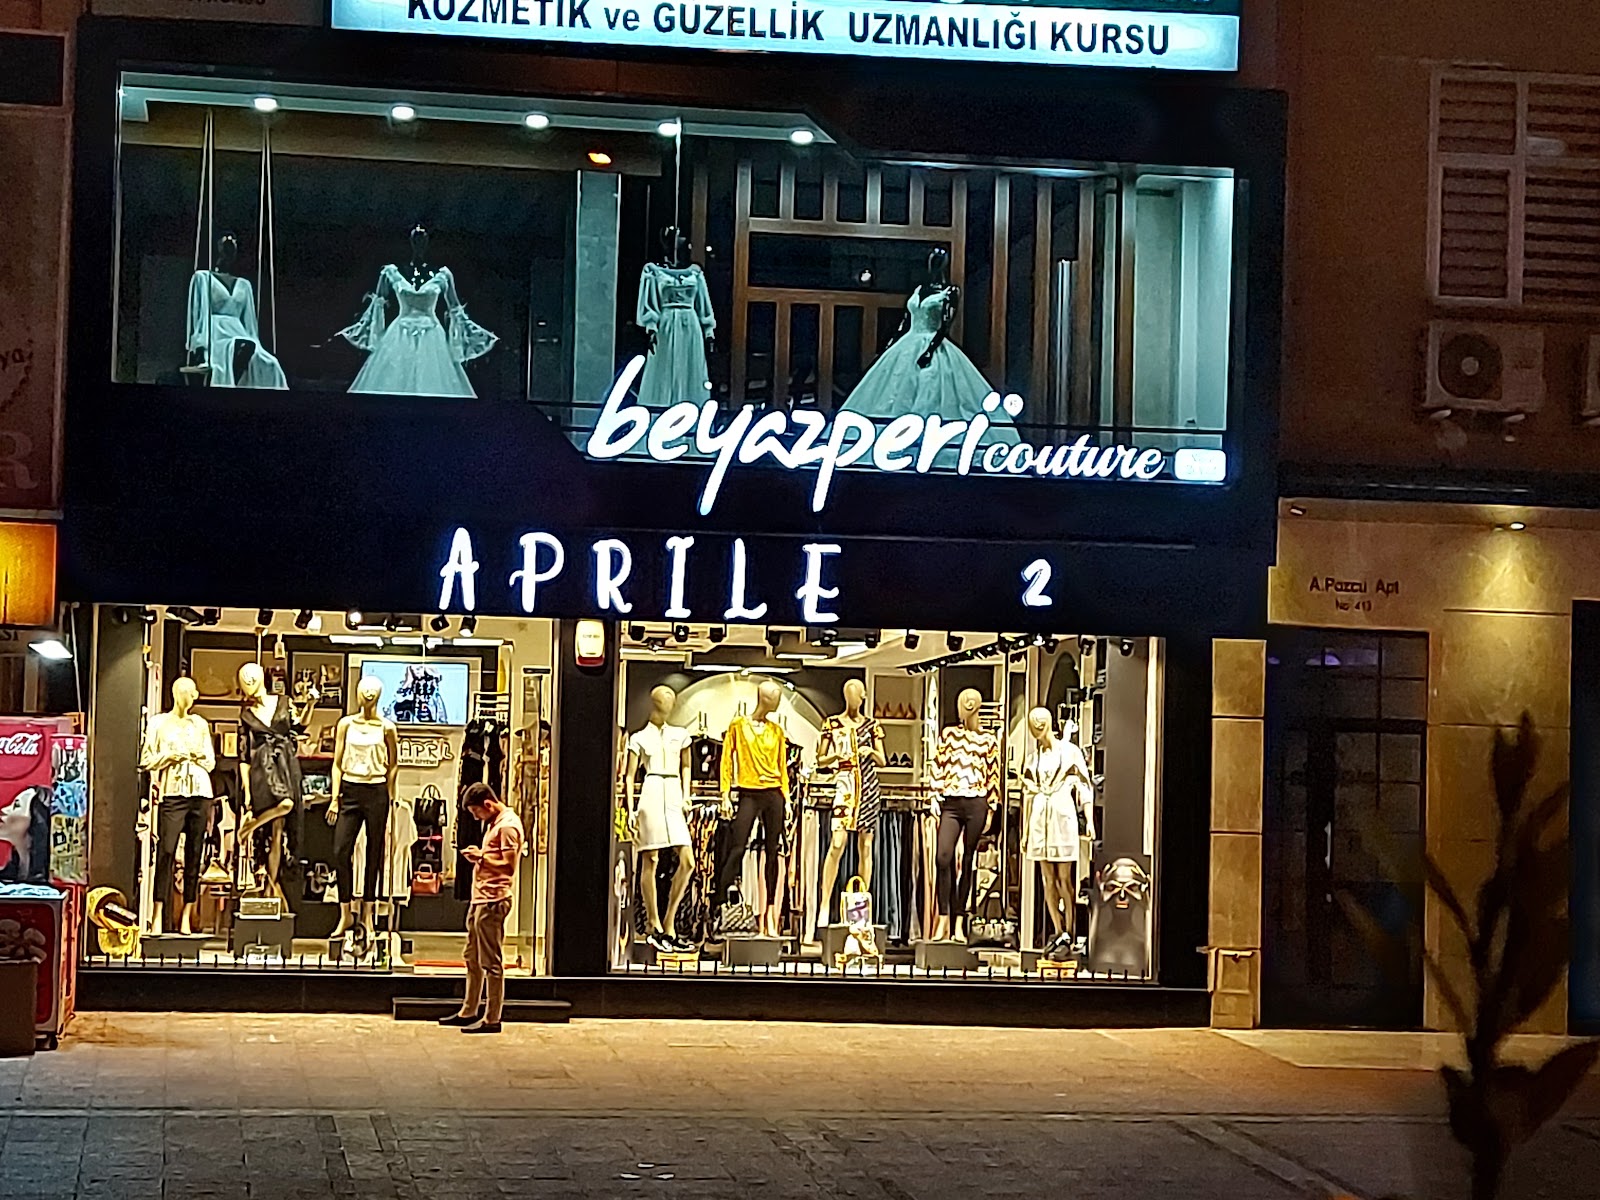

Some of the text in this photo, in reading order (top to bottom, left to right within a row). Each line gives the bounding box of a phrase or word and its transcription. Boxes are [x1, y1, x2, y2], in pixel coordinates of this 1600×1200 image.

[604, 7, 640, 31] ve
[849, 11, 1037, 51] UZMANLIĞI
[1050, 21, 1170, 55] KURSU
[982, 434, 1165, 480] couture
[438, 527, 1052, 623] APRILE 2
